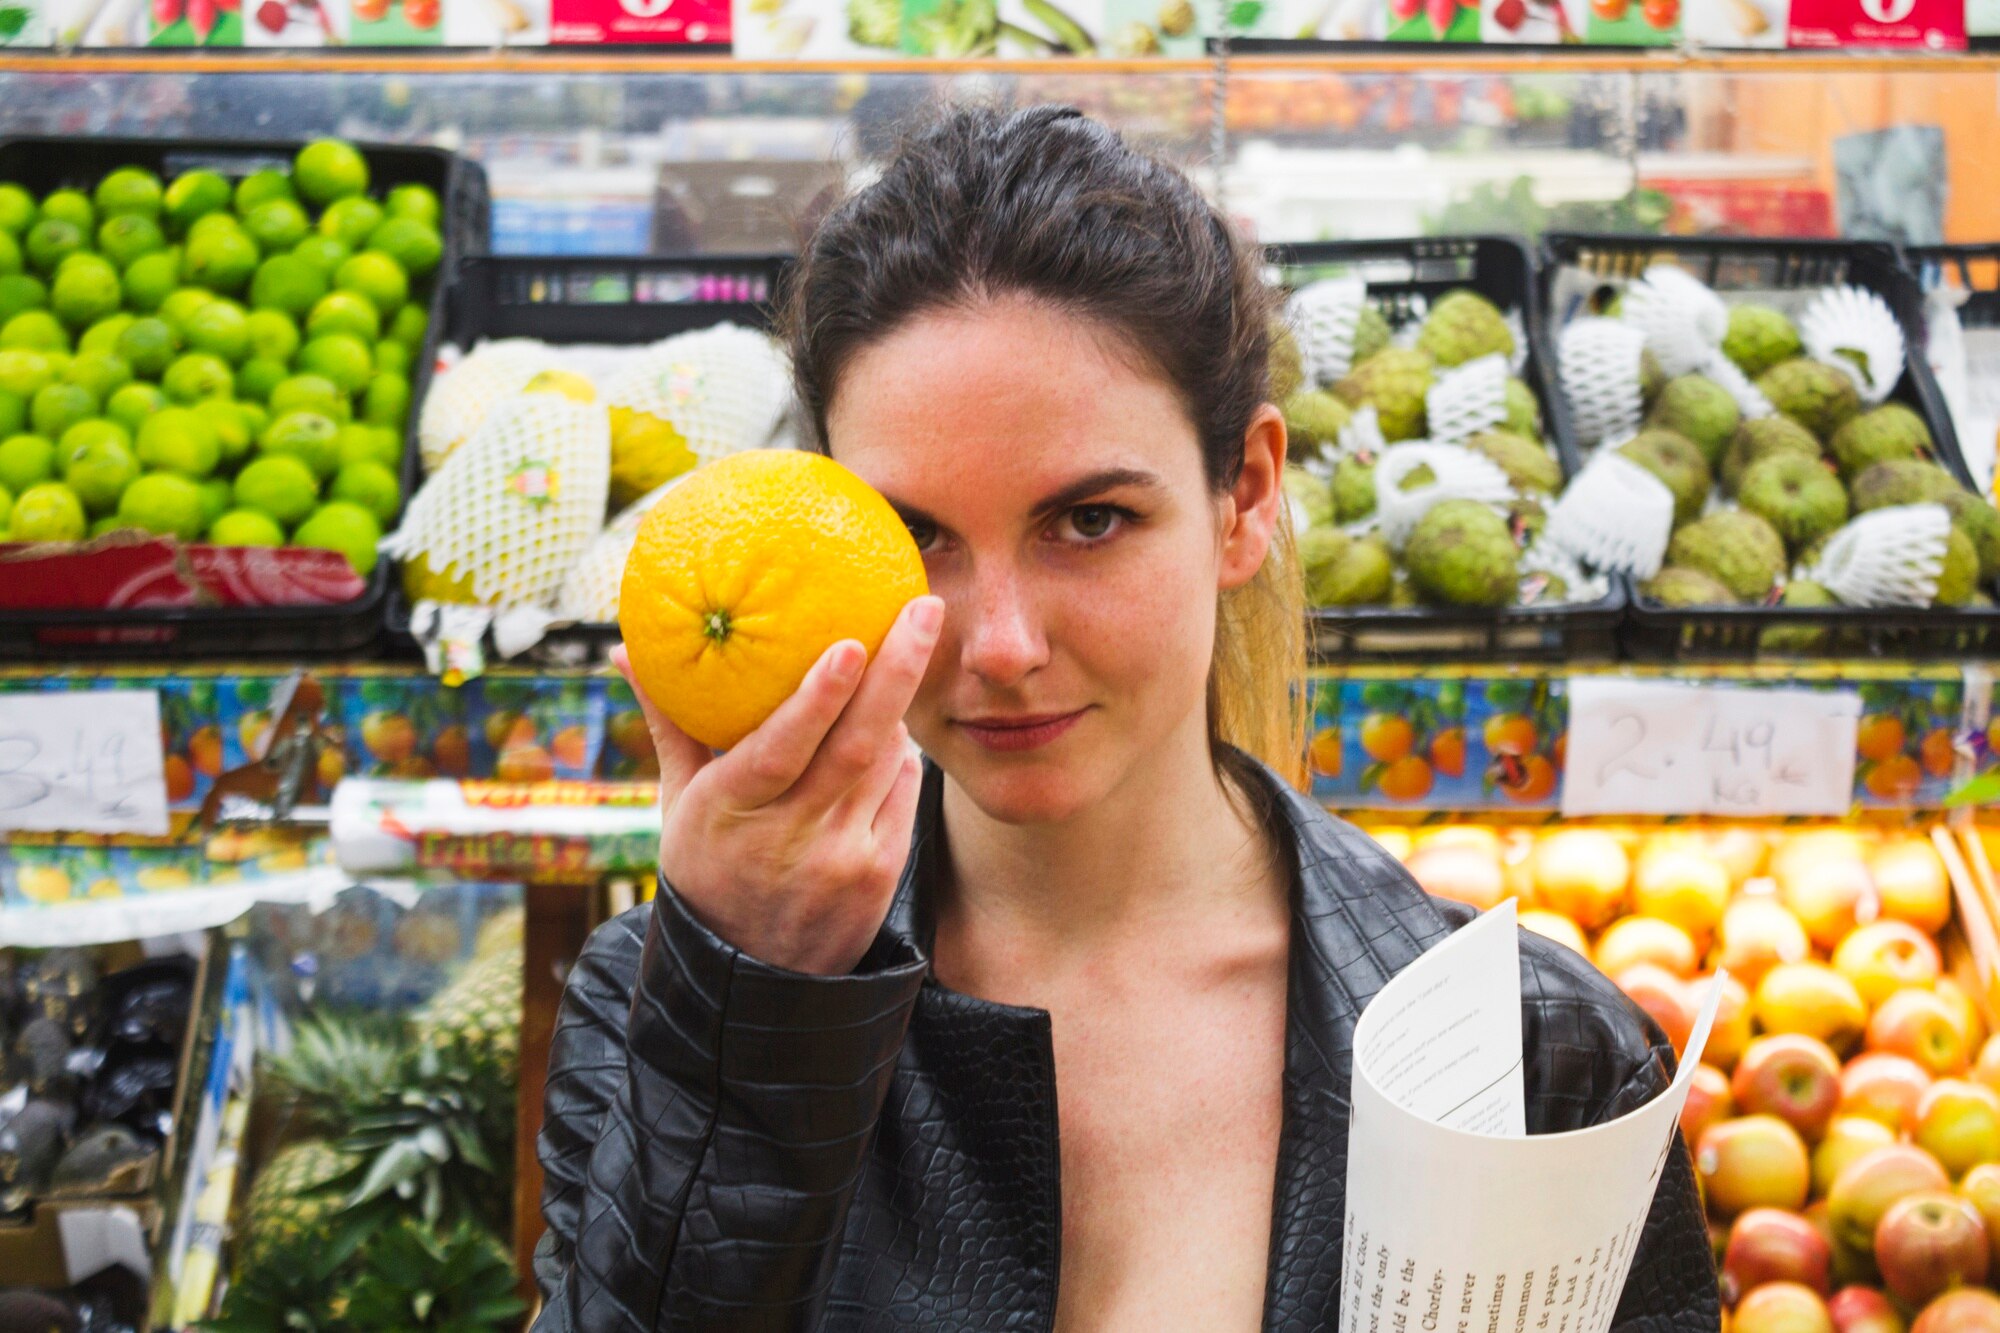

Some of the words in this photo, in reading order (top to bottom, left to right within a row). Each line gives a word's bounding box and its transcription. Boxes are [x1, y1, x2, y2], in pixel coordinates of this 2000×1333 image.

[1377, 1244, 1391, 1279] only
[1400, 1258, 1415, 1283] the
[1371, 1284, 1384, 1309] the
[1396, 1289, 1411, 1308] be
[1422, 1269, 1446, 1331] Chorley-
[1461, 1272, 1476, 1314] never
[1545, 1264, 1560, 1306] pages
[1562, 1275, 1578, 1305] had
[1579, 1271, 1595, 1310] book
